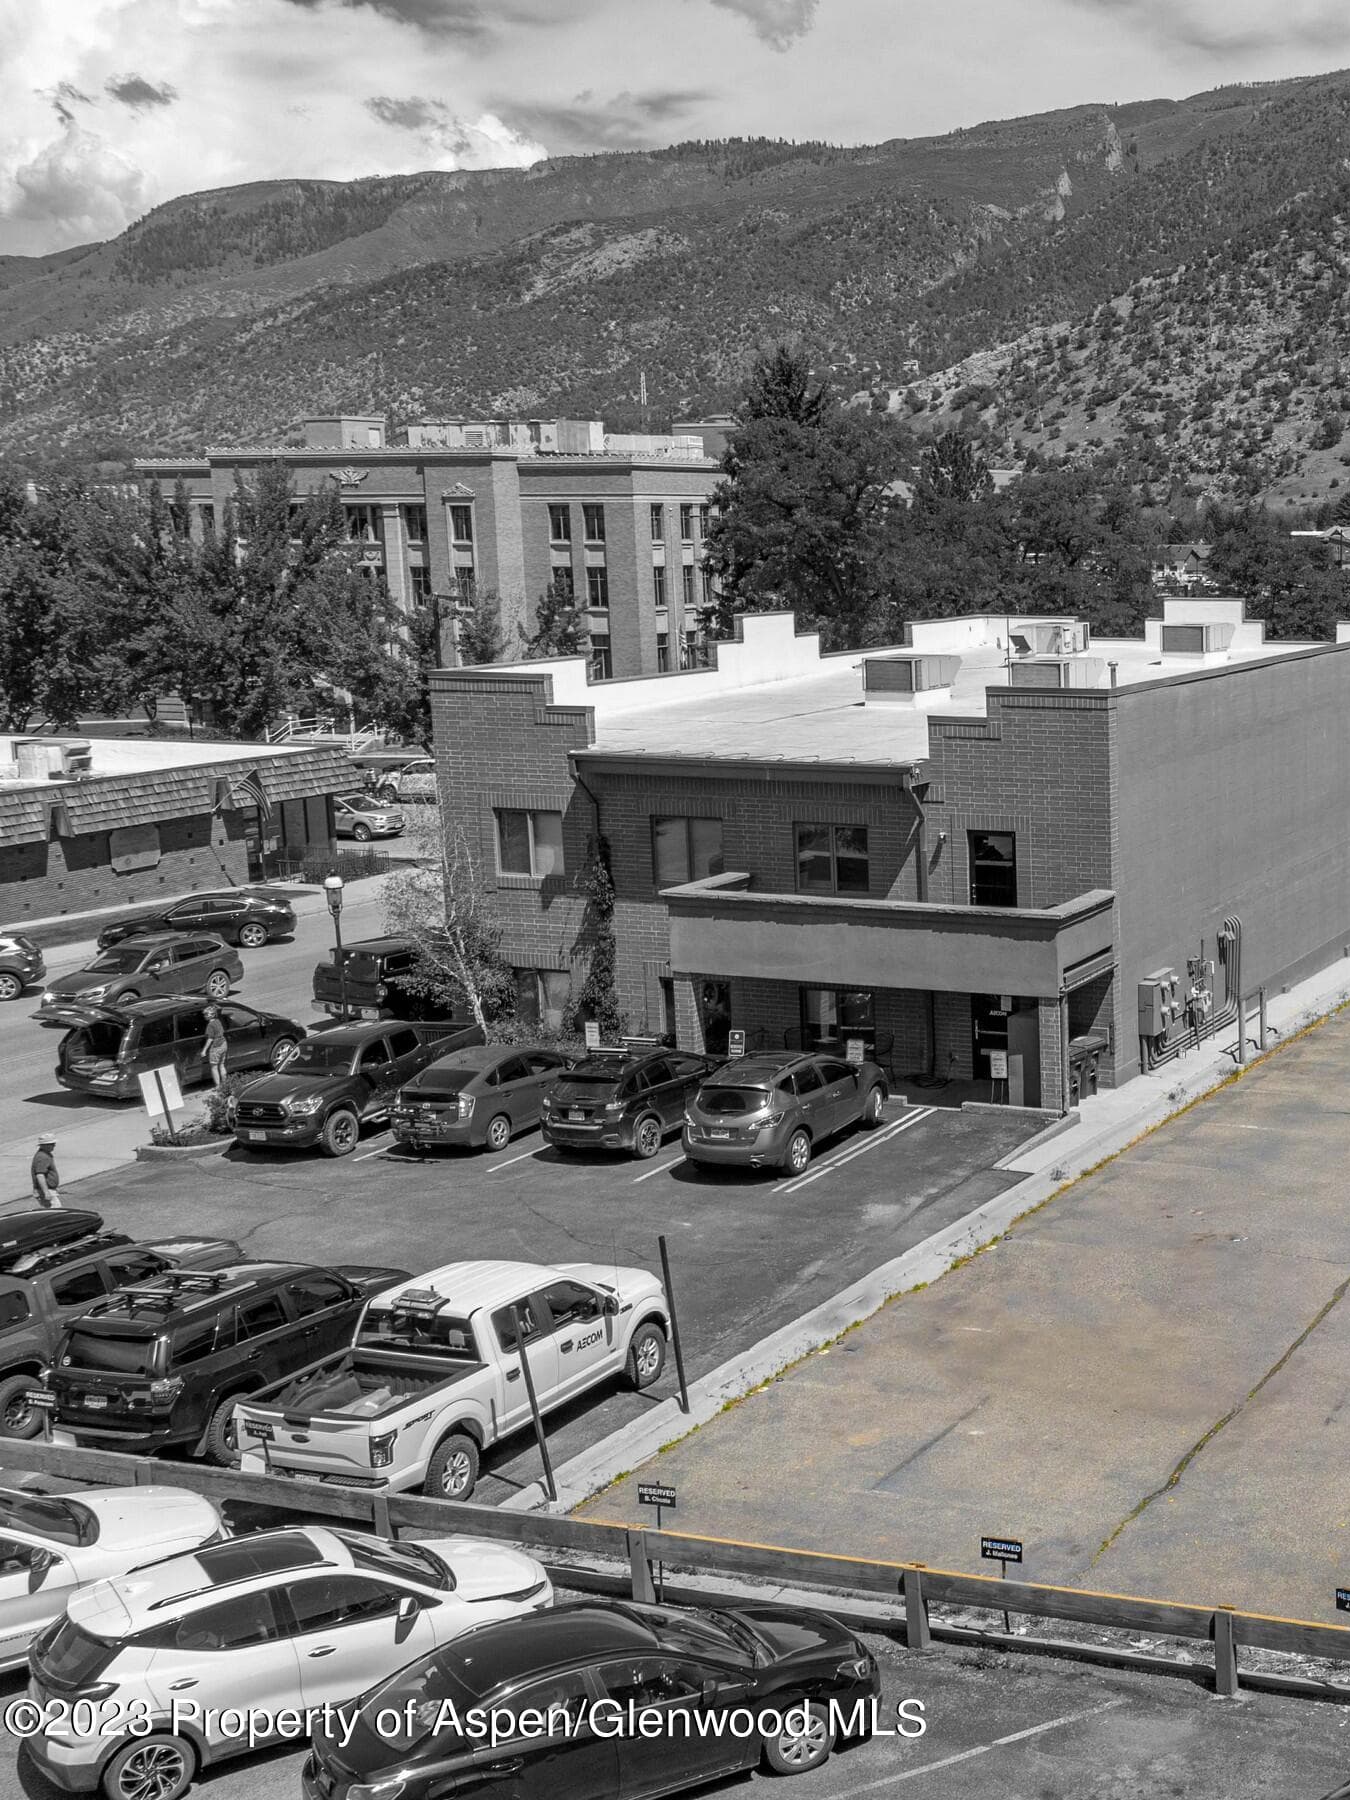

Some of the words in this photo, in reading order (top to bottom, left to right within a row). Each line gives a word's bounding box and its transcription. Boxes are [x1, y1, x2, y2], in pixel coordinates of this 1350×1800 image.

[576, 1329, 603, 1353] AECOM
[638, 1487, 676, 1498] RESERVED
[982, 1541, 1021, 1553] RESERVED
